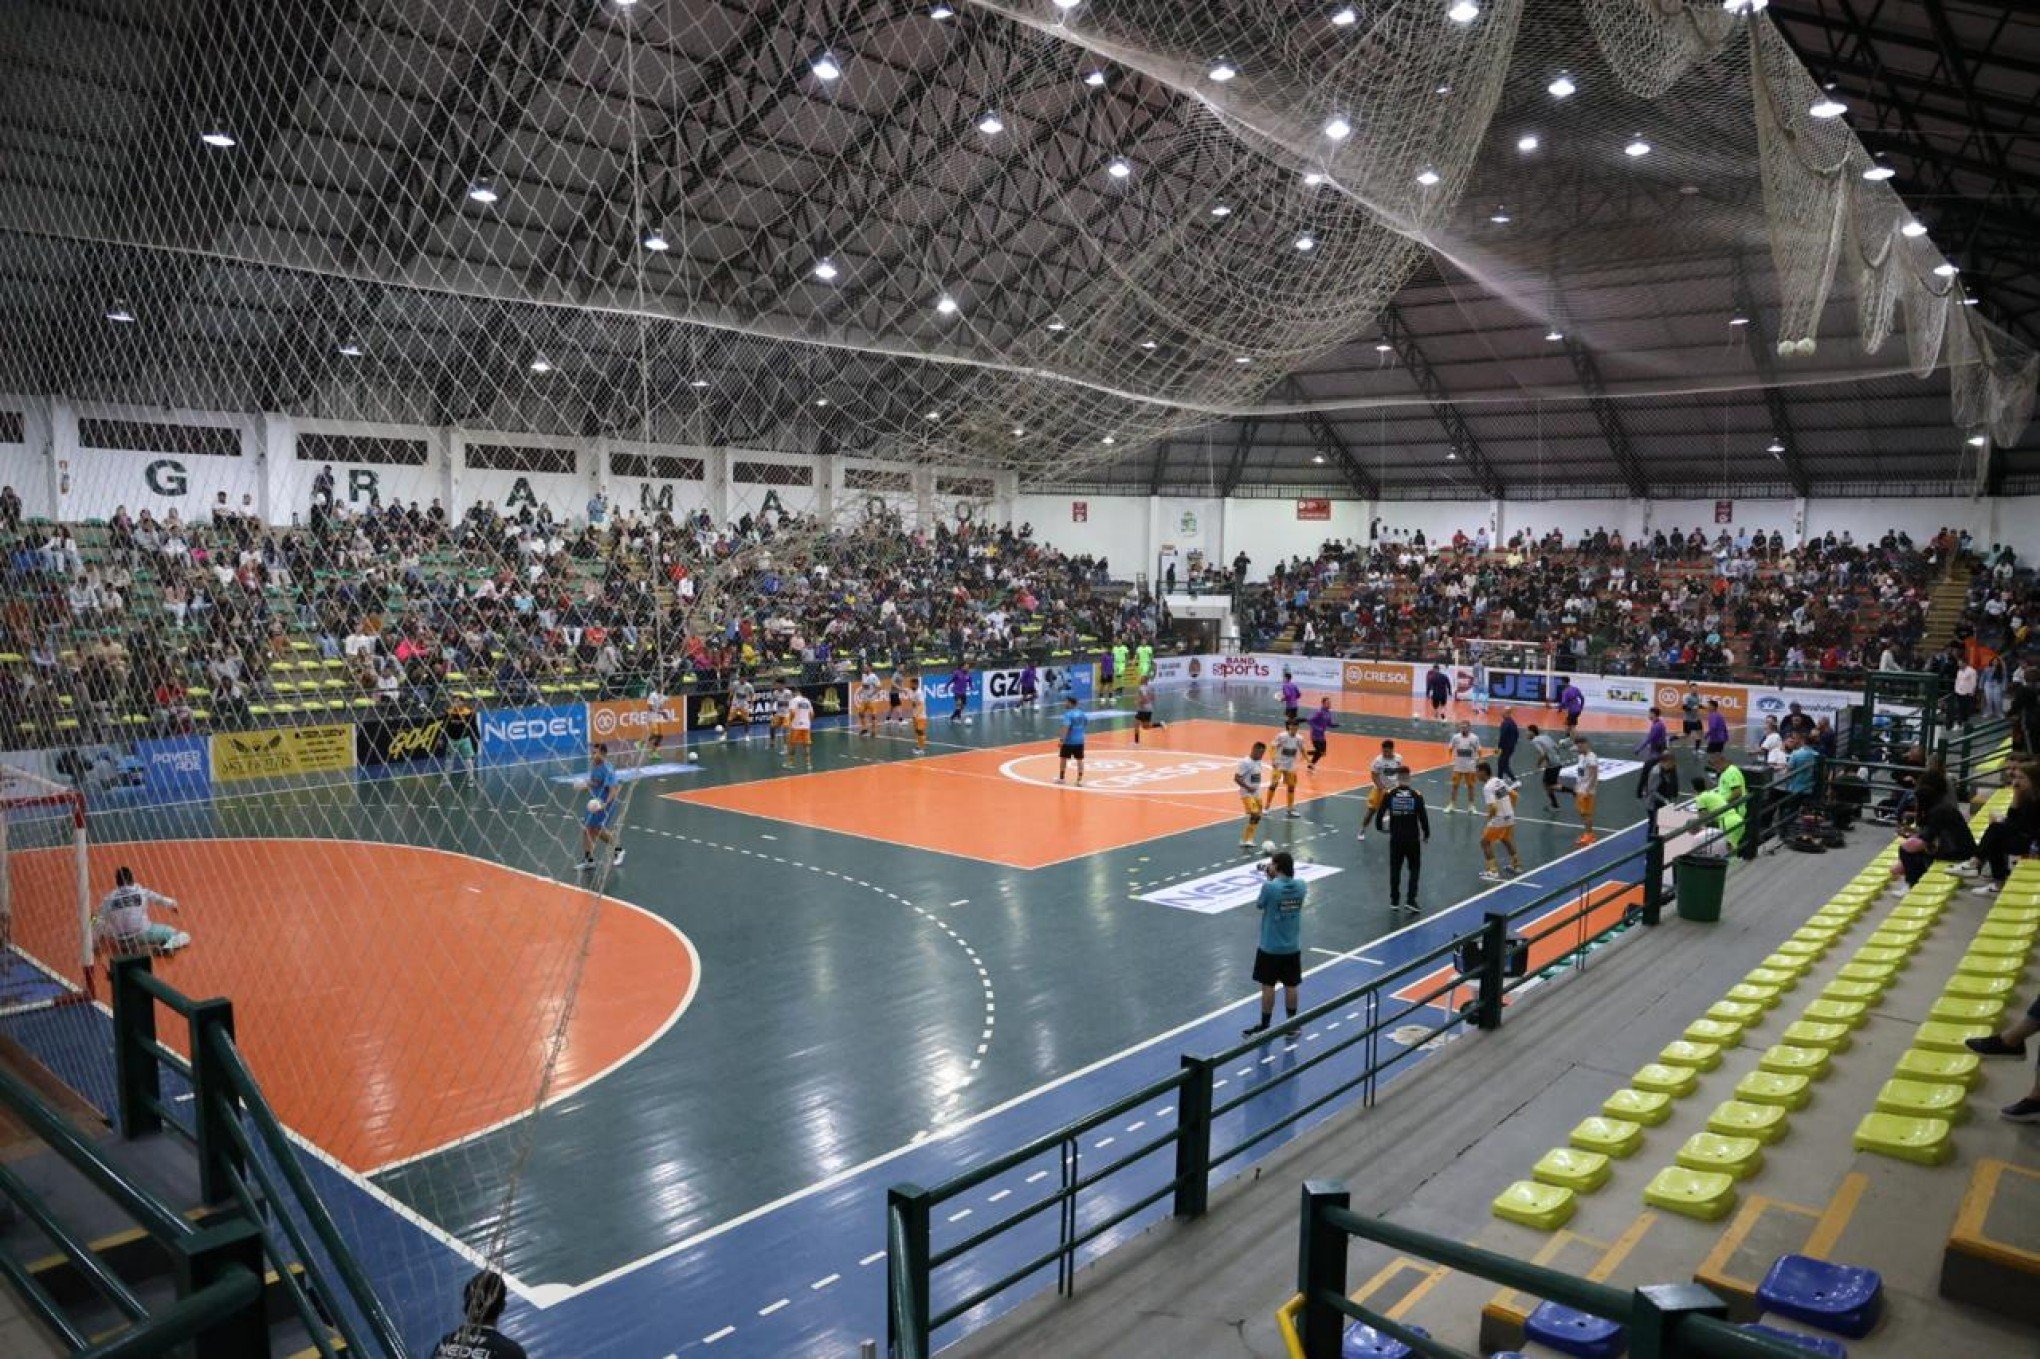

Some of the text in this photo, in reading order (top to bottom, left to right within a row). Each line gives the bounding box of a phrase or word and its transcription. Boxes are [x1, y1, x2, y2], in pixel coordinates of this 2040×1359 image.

[1226, 656, 1255, 665] BAND
[1363, 670, 1409, 684] CRESOL
[485, 717, 580, 742] NEDEL
